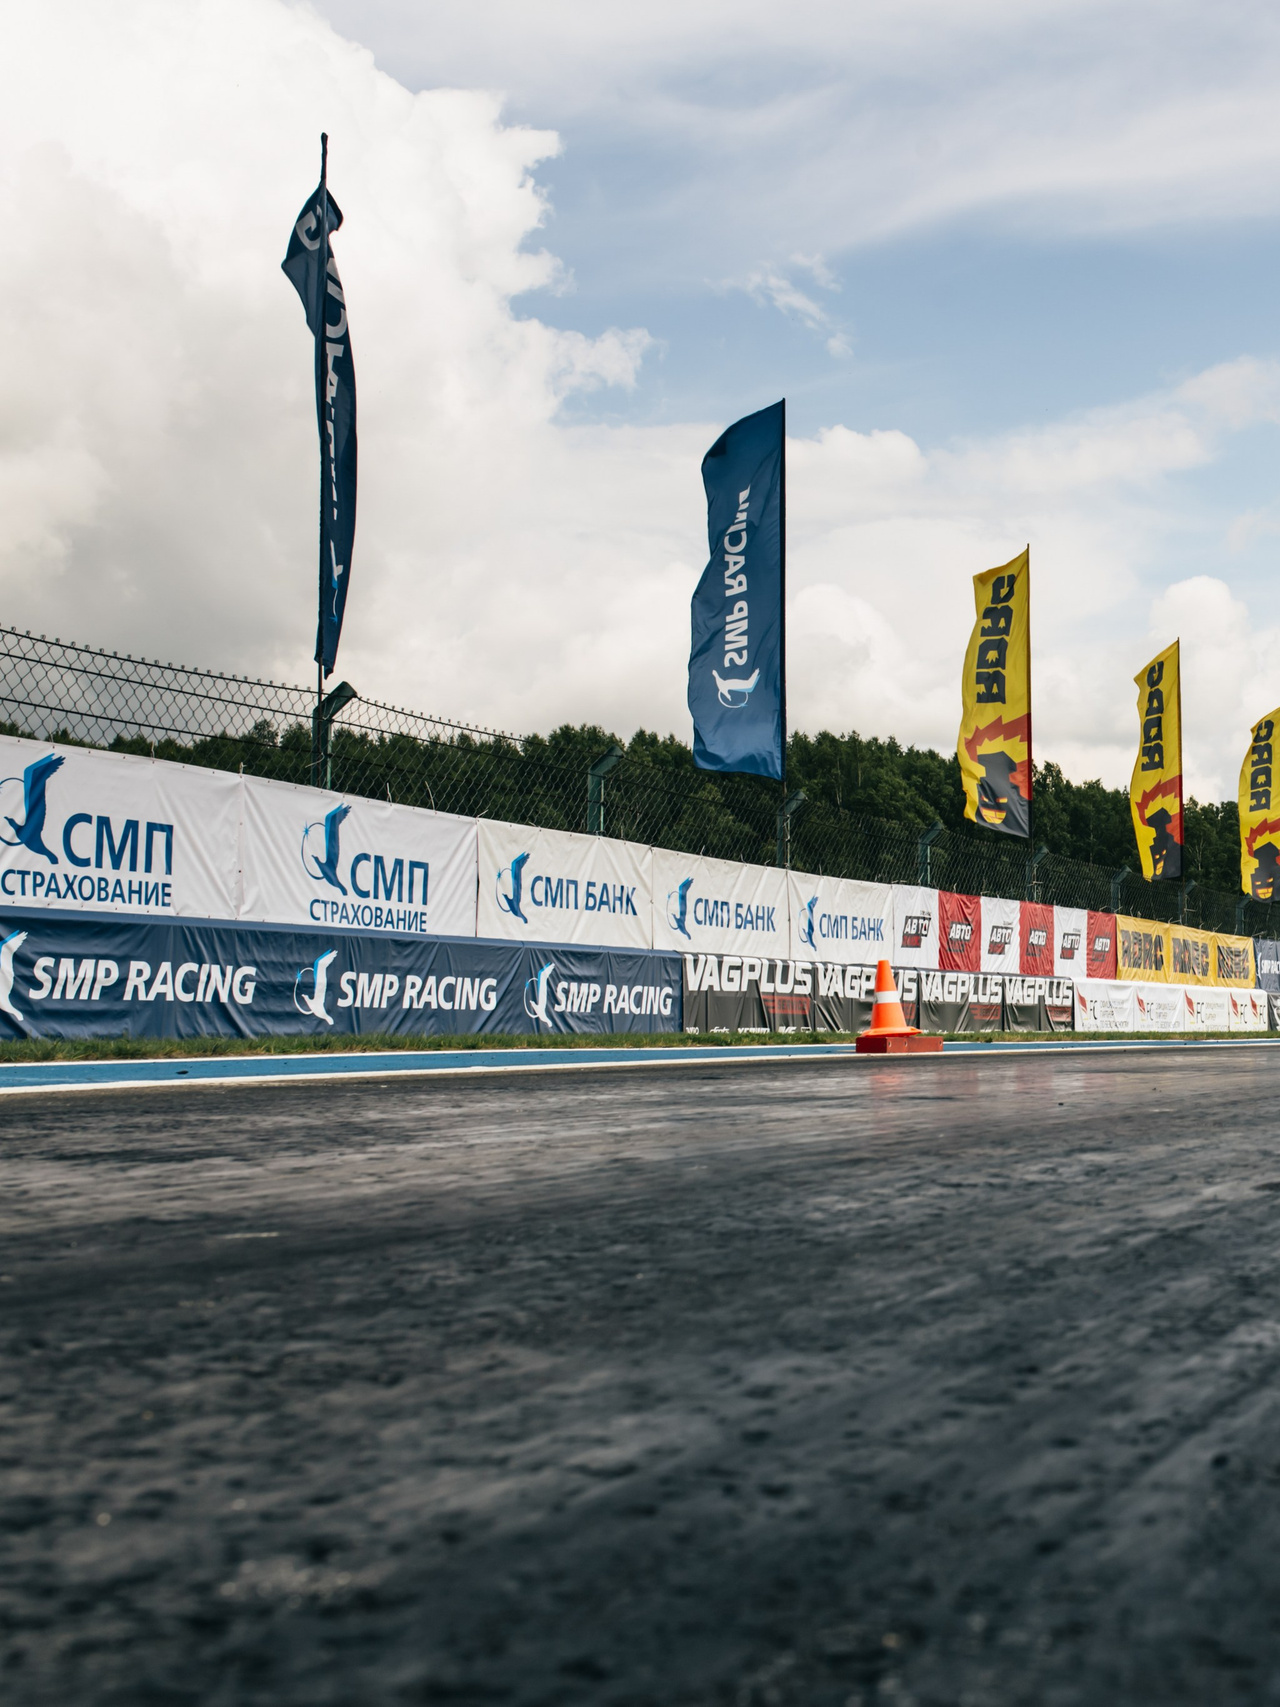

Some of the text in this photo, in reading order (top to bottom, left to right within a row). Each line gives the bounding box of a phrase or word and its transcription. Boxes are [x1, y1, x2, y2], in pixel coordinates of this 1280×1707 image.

[62, 812, 174, 876] СМП
[1, 869, 172, 907] СТРАХОВАНИЕ
[350, 852, 430, 906] СМП
[530, 875, 638, 916] СМП БАНК
[309, 898, 427, 933] СТРАХОВАНИЕ
[693, 897, 776, 933] СМП БАНК
[819, 913, 848, 940] СМП
[851, 916, 885, 942] БАНК
[28, 956, 257, 1005] SMP RACING
[337, 970, 498, 1012] SMP RACING
[684, 954, 813, 995] VAGPLUS
[920, 970, 1003, 1003] VAGPLUS
[1004, 976, 1073, 1006] VAGPLUS
[554, 981, 673, 1016] SMP RACING
